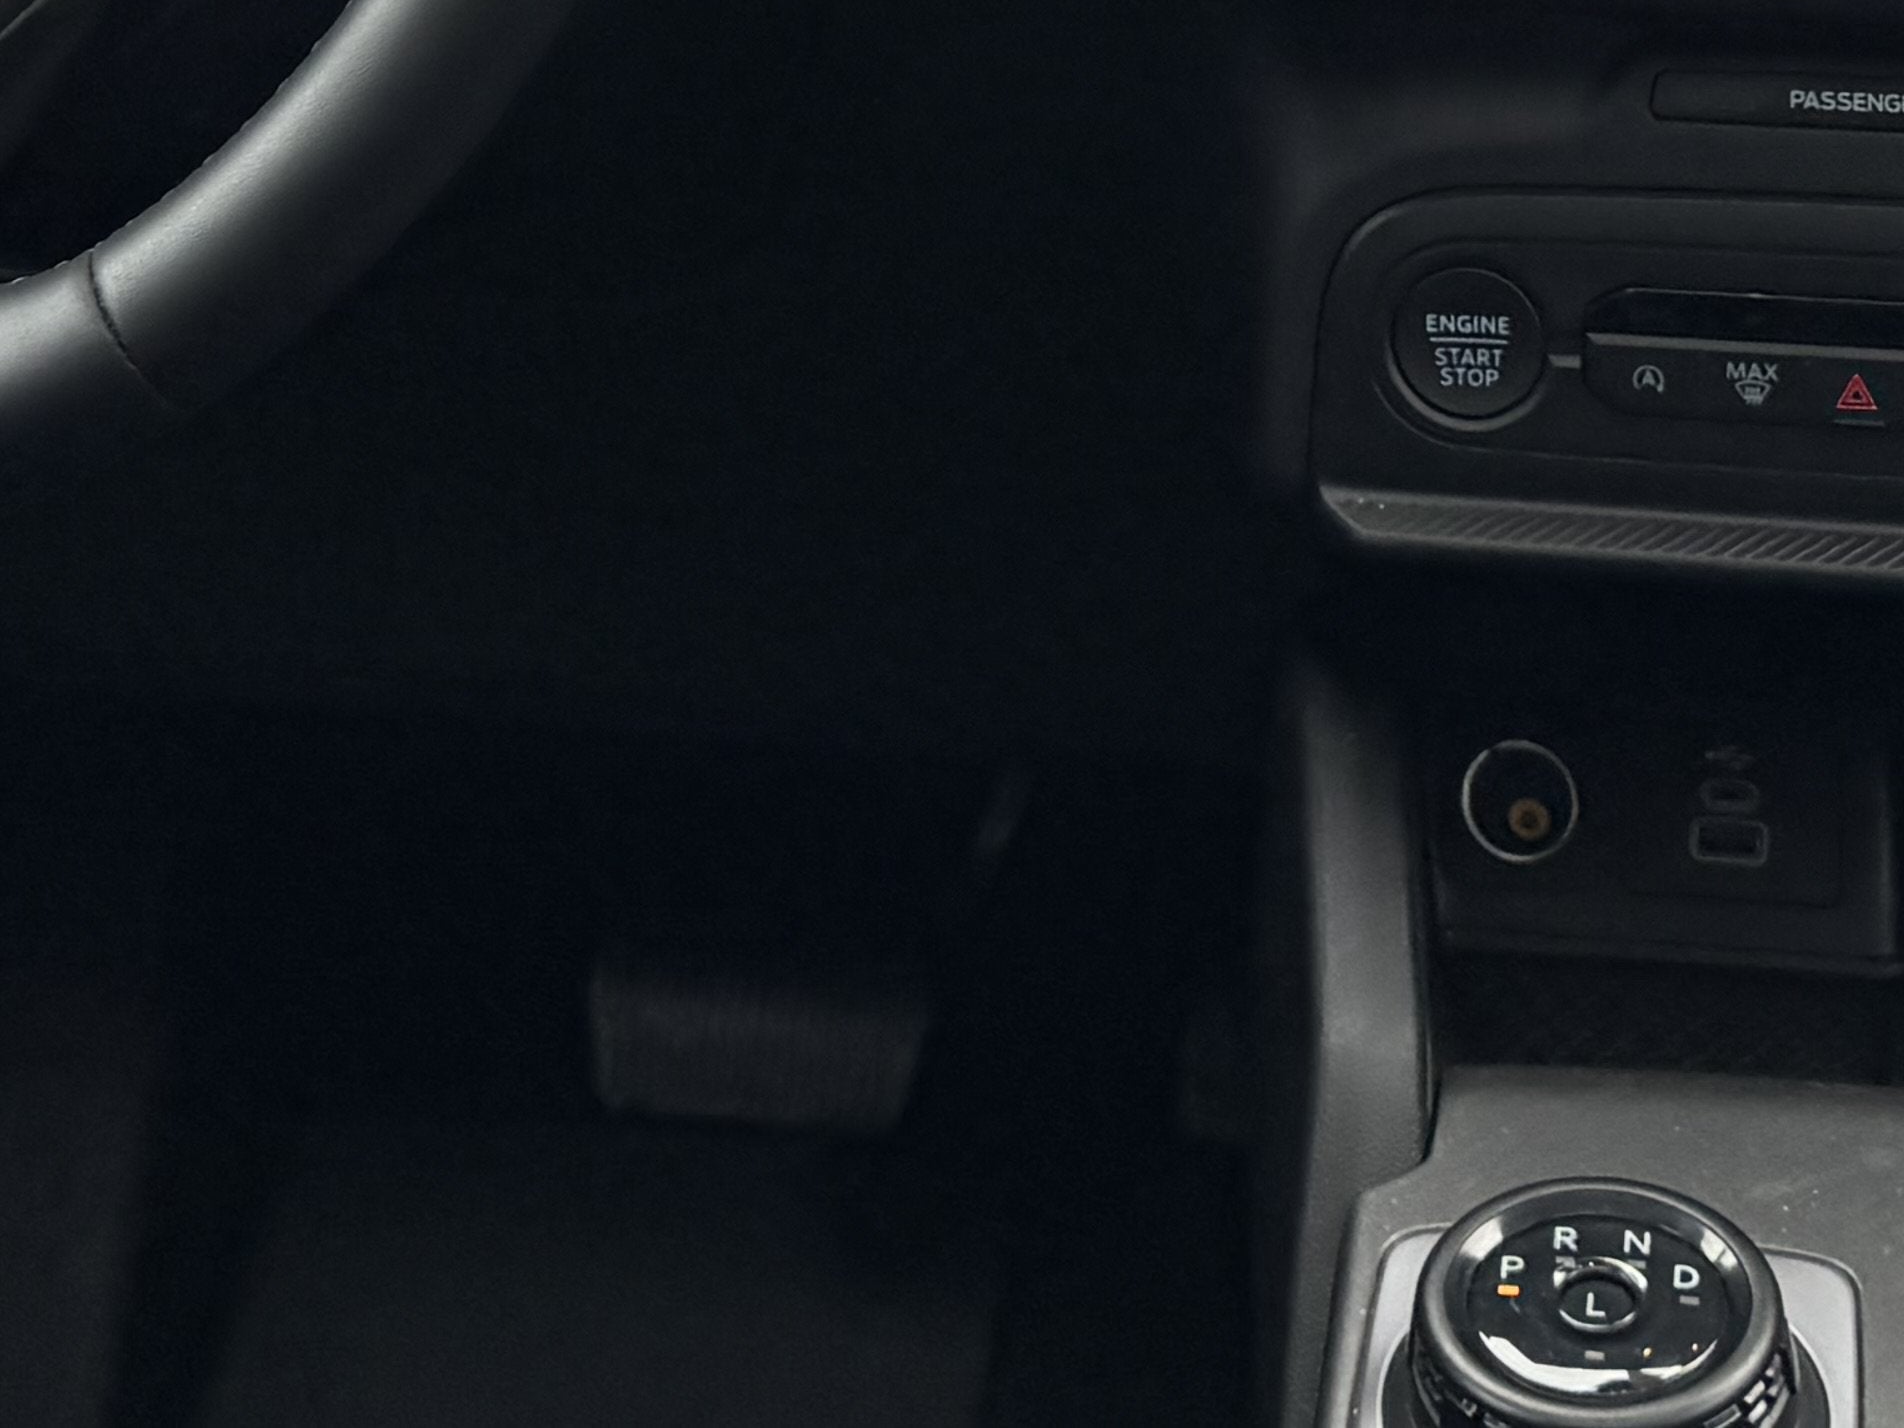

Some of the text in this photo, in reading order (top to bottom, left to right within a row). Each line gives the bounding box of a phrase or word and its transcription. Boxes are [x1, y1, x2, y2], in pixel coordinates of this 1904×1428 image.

[1425, 313, 1511, 336] ENGINE
[1434, 347, 1503, 369] START
[1439, 367, 1500, 388] STOP
[1725, 361, 1779, 383] MAX
[1553, 1226, 1580, 1251] R
[1623, 1229, 1652, 1255] N
[1500, 1257, 1526, 1280] P
[1672, 1264, 1701, 1290] D
[1585, 1292, 1606, 1317] L
